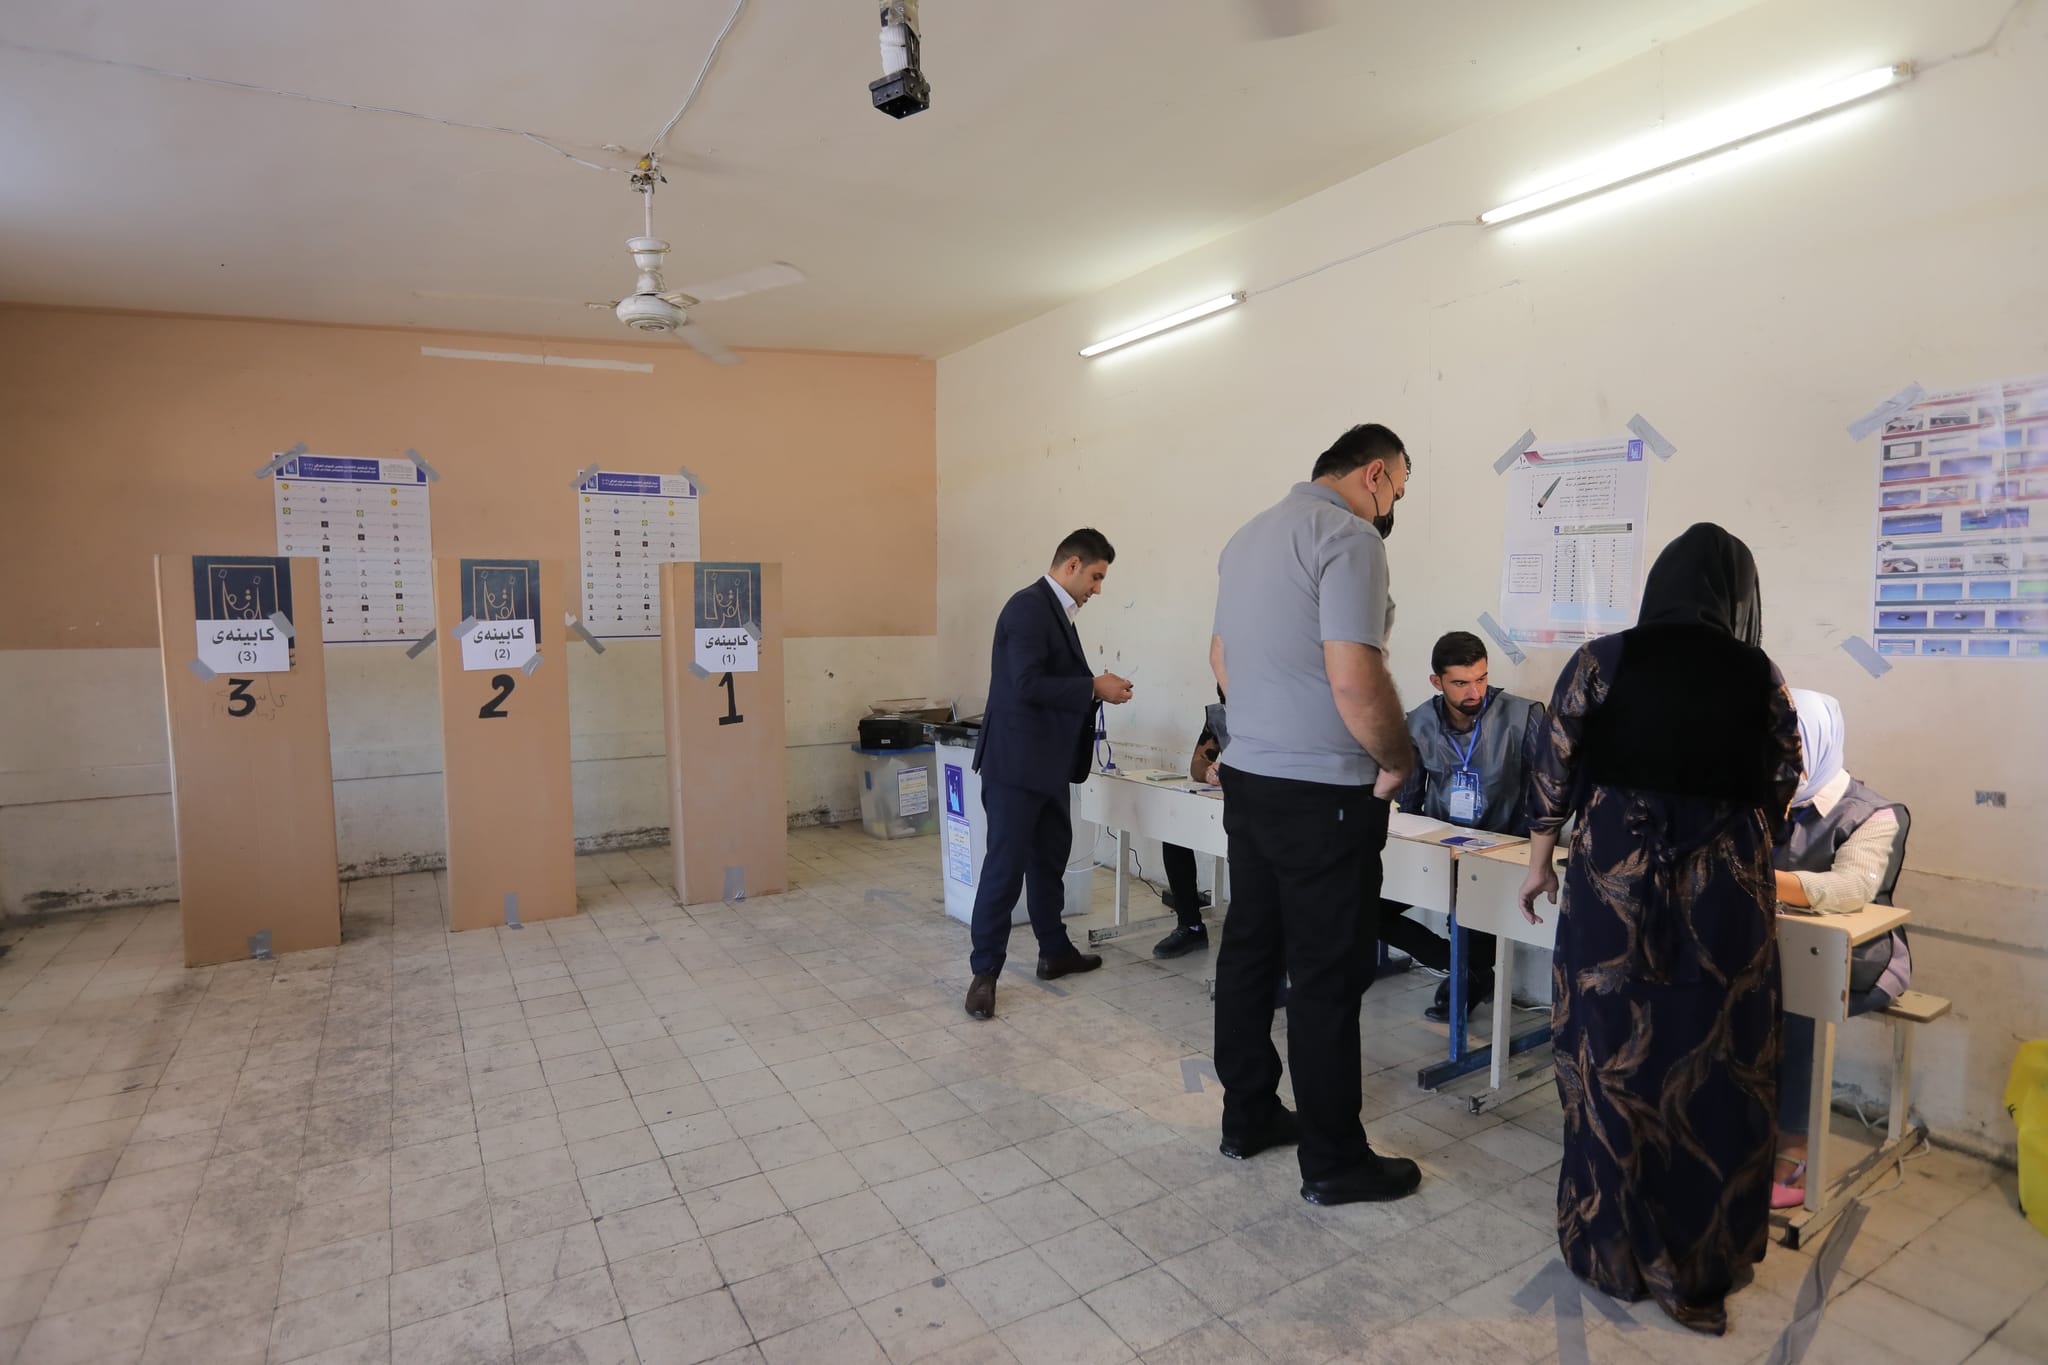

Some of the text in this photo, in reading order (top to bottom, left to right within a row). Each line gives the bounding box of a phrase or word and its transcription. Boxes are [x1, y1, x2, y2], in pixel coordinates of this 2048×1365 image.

[238, 650, 257, 664] (3)
[494, 648, 511, 661] (2)
[722, 654, 736, 665] (1)
[228, 678, 257, 717] 3
[478, 674, 515, 719] 2
[718, 671, 744, 726] 1
